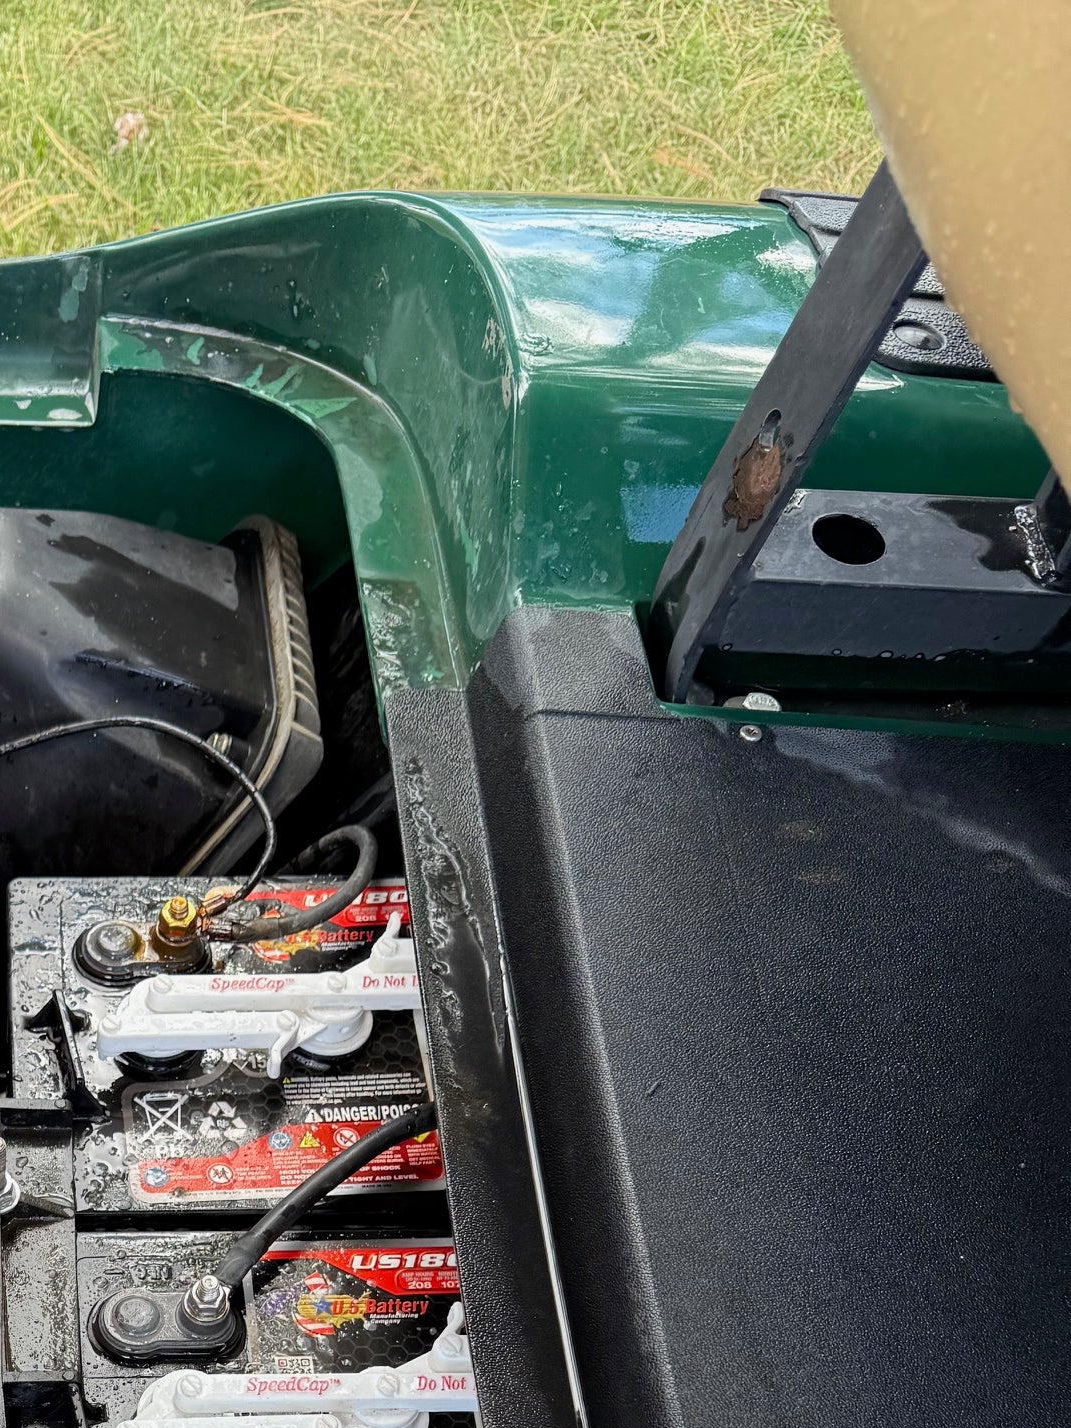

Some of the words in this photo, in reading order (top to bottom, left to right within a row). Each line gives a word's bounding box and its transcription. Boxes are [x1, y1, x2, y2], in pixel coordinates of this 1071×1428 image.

[319, 930, 374, 943] Battery
[362, 976, 379, 988] Do
[384, 975, 405, 988] Not
[248, 1053, 267, 1069] 15
[408, 1281, 431, 1289] 208
[365, 1298, 429, 1315] Battery
[417, 1376, 437, 1391] Do
[441, 1376, 467, 1391] Not
